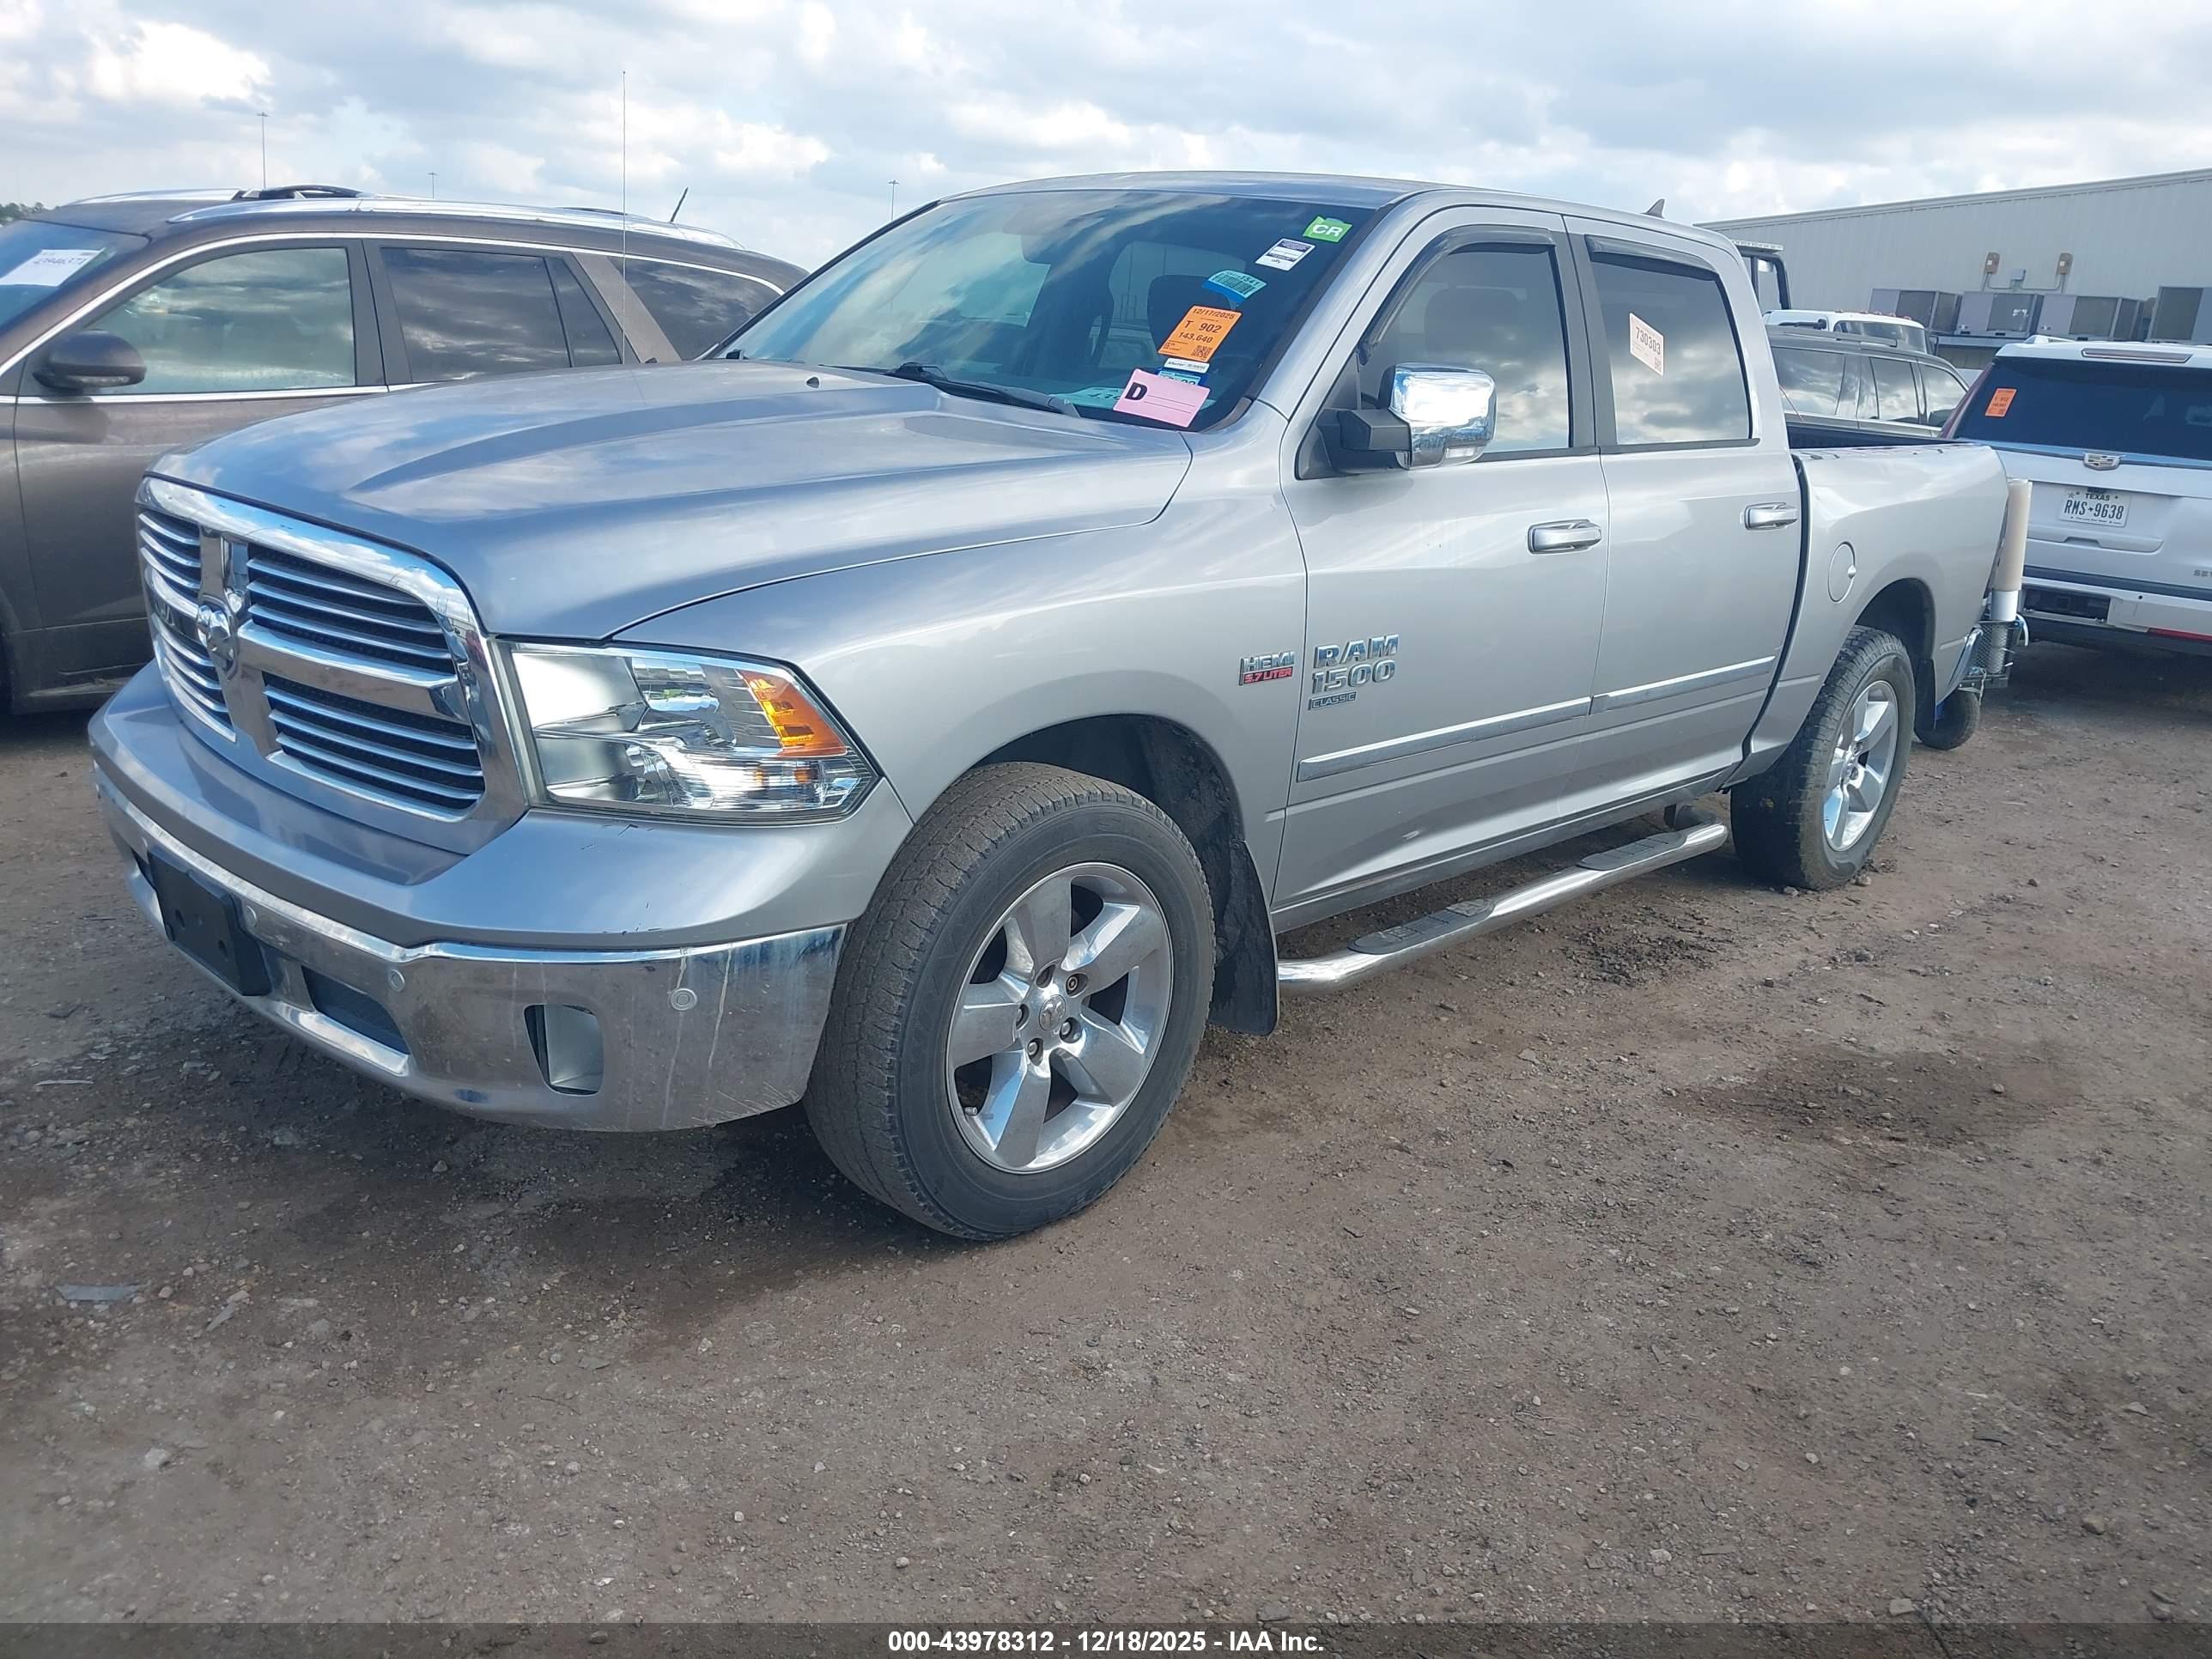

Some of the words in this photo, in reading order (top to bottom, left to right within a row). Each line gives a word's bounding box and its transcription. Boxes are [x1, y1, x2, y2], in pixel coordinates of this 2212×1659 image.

[1313, 224, 1343, 237] CR
[1193, 308, 1236, 319] 12/17/2025
[1184, 320, 1194, 329] T
[1199, 322, 1223, 333] 902
[1636, 326, 1661, 356] 730303
[1124, 381, 1148, 401] D
[2085, 493, 2111, 501] TEXAS
[1314, 634, 1400, 669] RAM
[1242, 651, 1296, 672] HEMI
[1243, 672, 1263, 684] 5.7
[1263, 667, 1293, 680] LITER
[1312, 659, 1396, 694] 1500
[1311, 692, 1357, 709] CLASSIC
